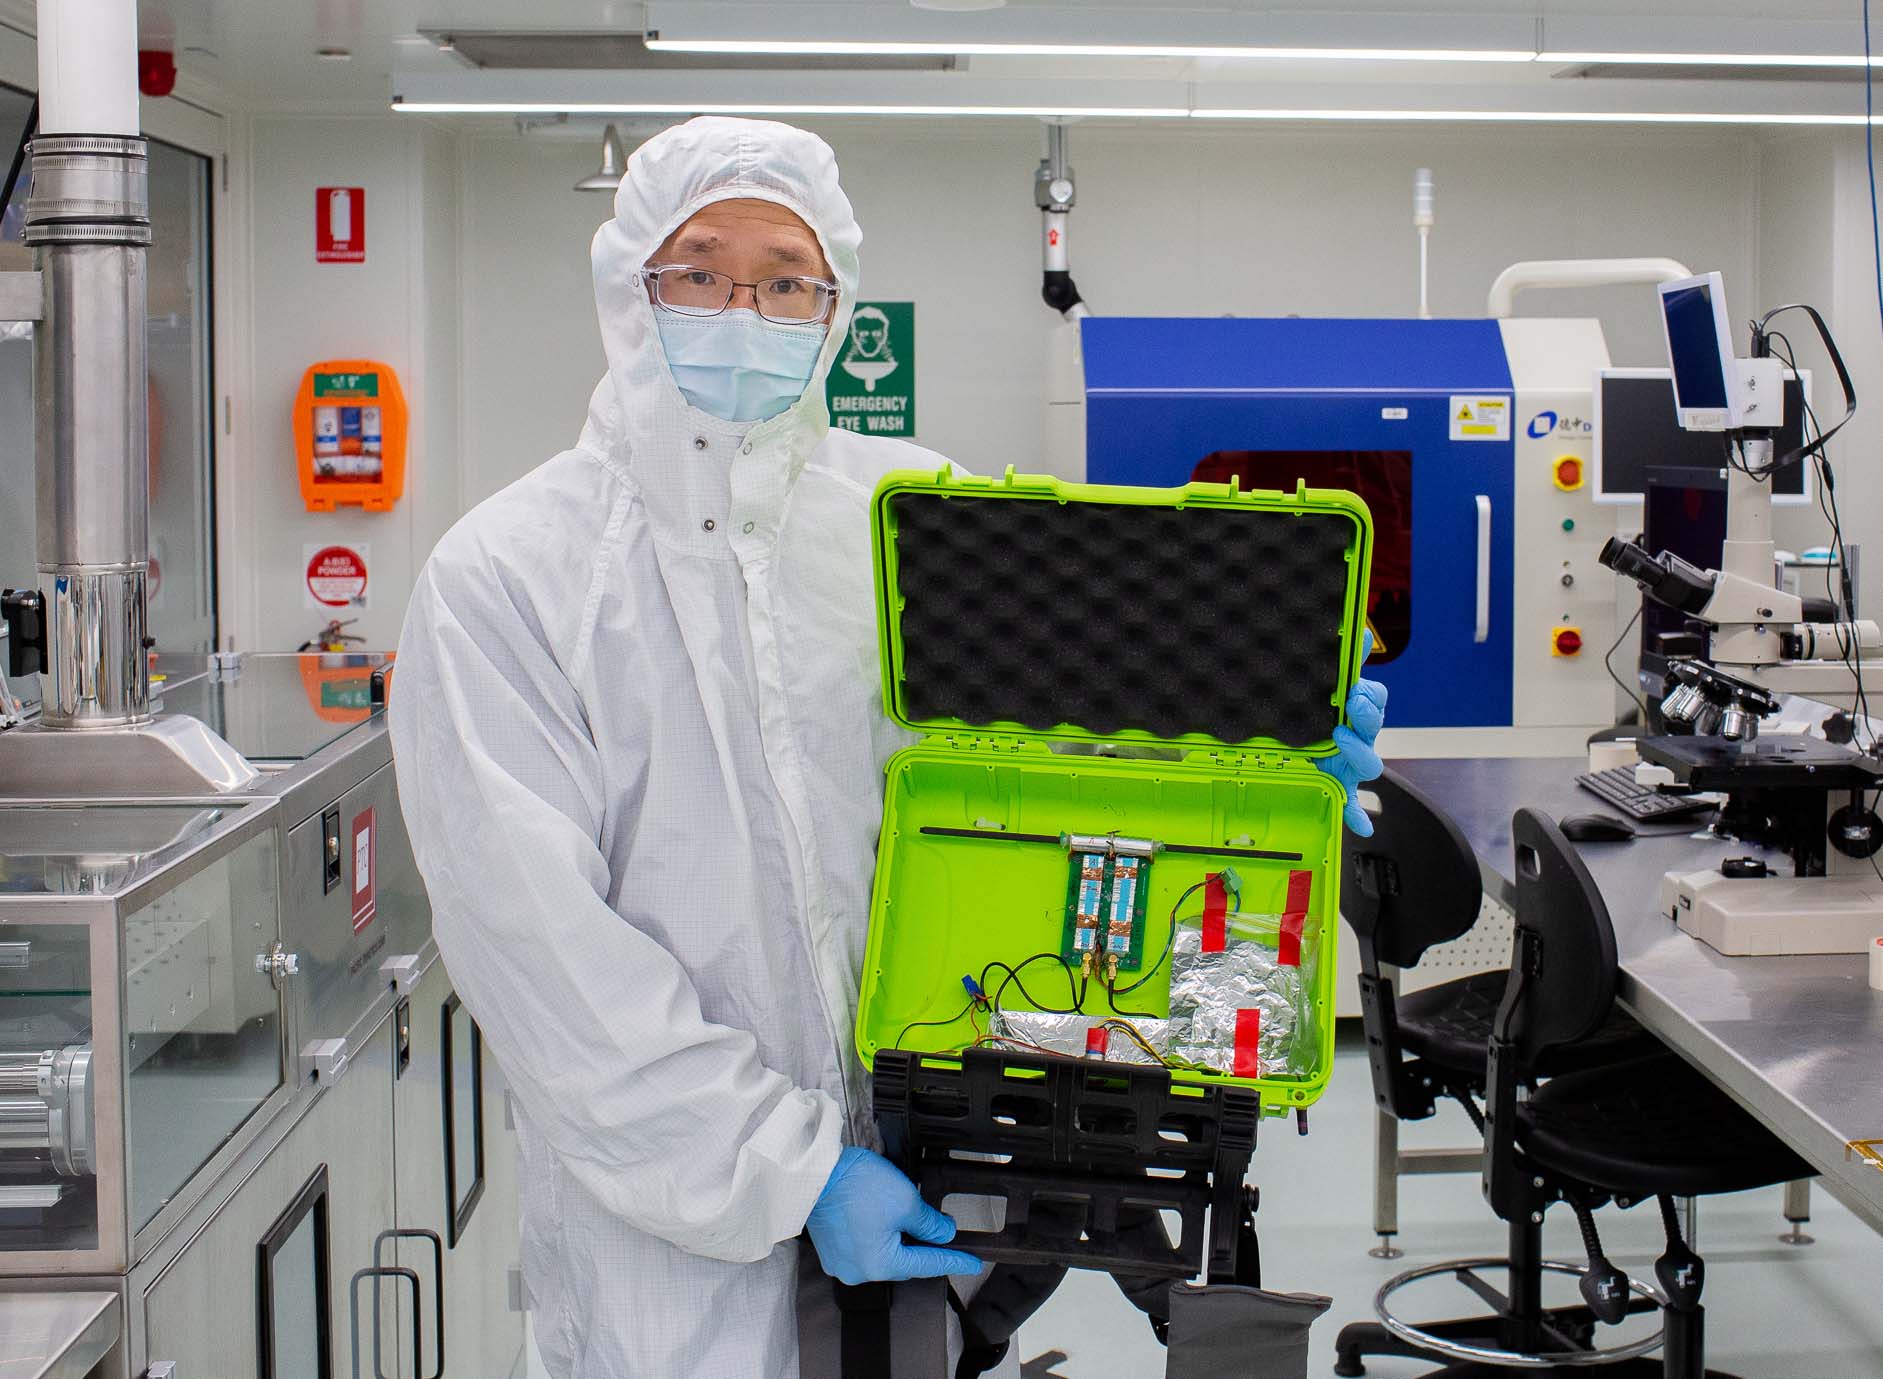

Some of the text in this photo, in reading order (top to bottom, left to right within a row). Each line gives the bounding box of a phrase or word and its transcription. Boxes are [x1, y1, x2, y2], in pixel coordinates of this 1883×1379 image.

[832, 396, 908, 412] EMERGENCY
[837, 415, 904, 431] EYE WASH
